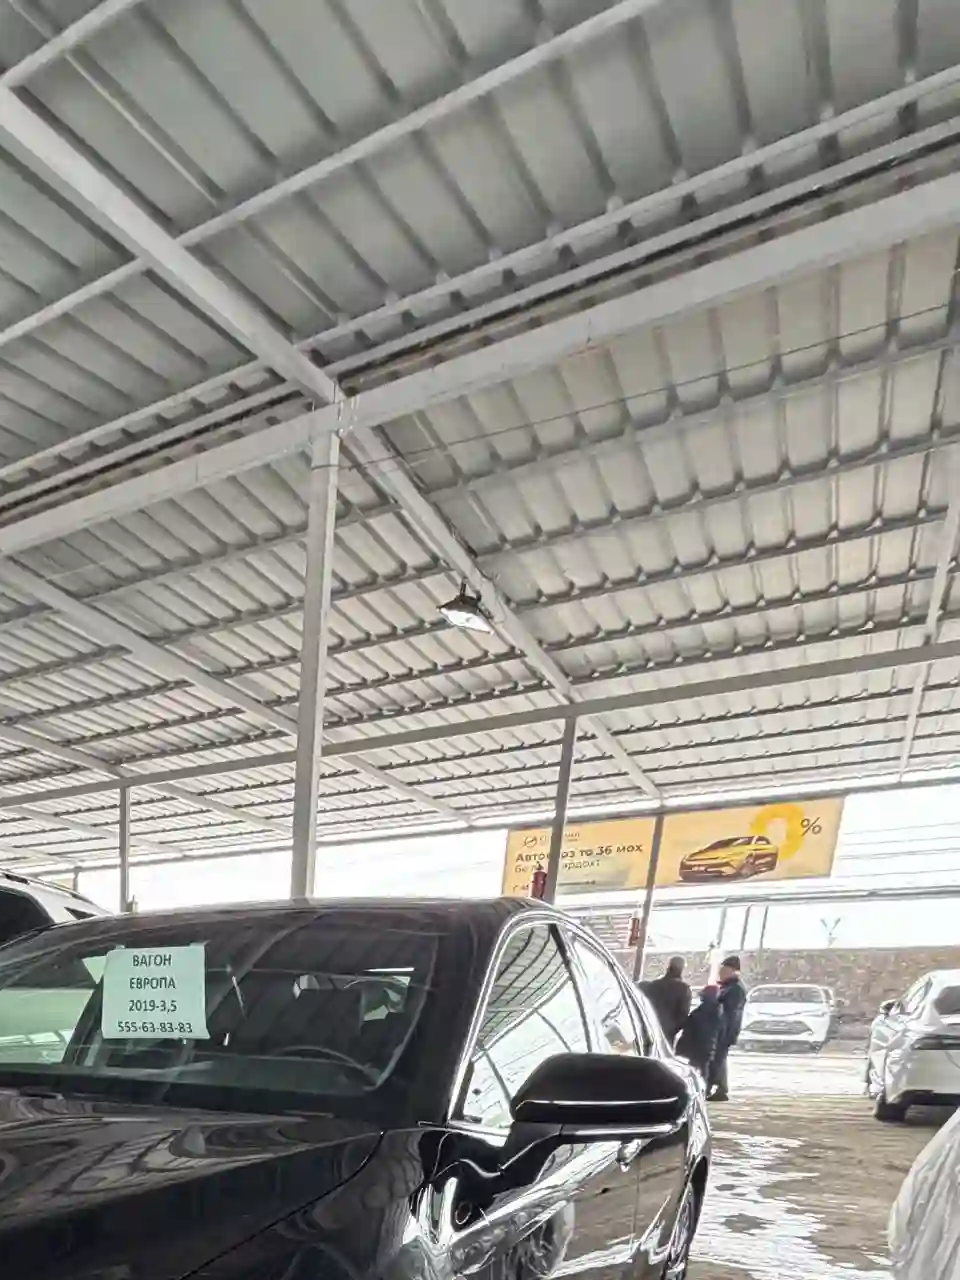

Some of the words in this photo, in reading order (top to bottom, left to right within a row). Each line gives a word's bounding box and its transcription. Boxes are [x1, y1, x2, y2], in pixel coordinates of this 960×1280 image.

[132, 954, 172, 967] ВАГОН
[129, 977, 177, 990] ЕВРОПА
[128, 1000, 177, 1014] 2019-3,5
[117, 1021, 193, 1033] 555-63-83-83
